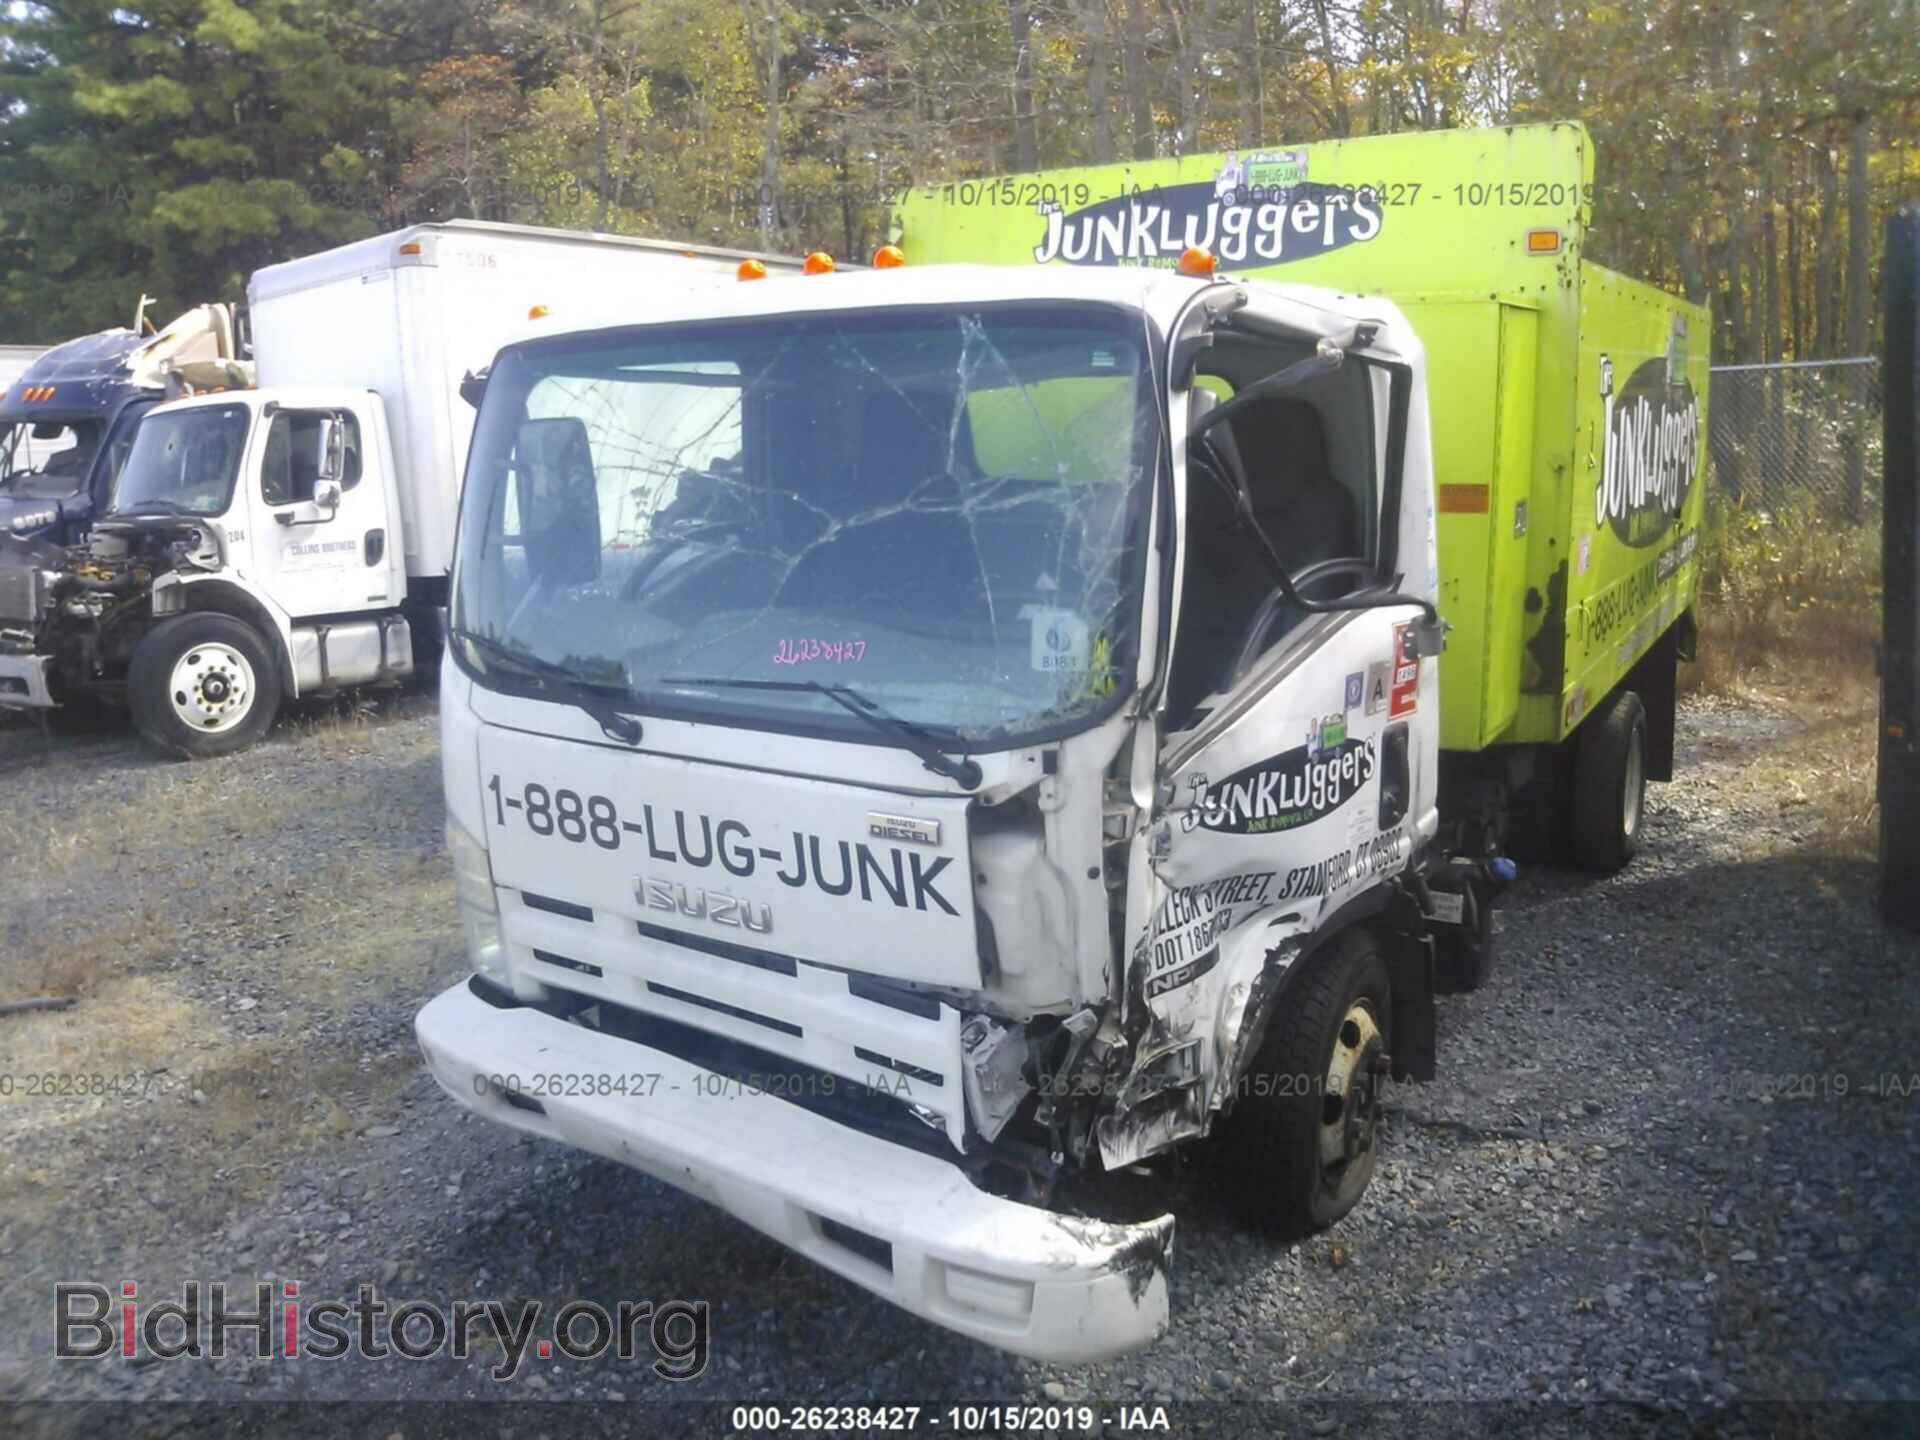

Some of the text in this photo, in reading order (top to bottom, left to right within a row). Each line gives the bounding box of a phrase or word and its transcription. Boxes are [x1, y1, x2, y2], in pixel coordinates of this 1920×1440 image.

[488, 774, 960, 917] 1-888-LUG-JUNK
[869, 824, 938, 848] DIESEL
[633, 875, 774, 935] ISUZU
